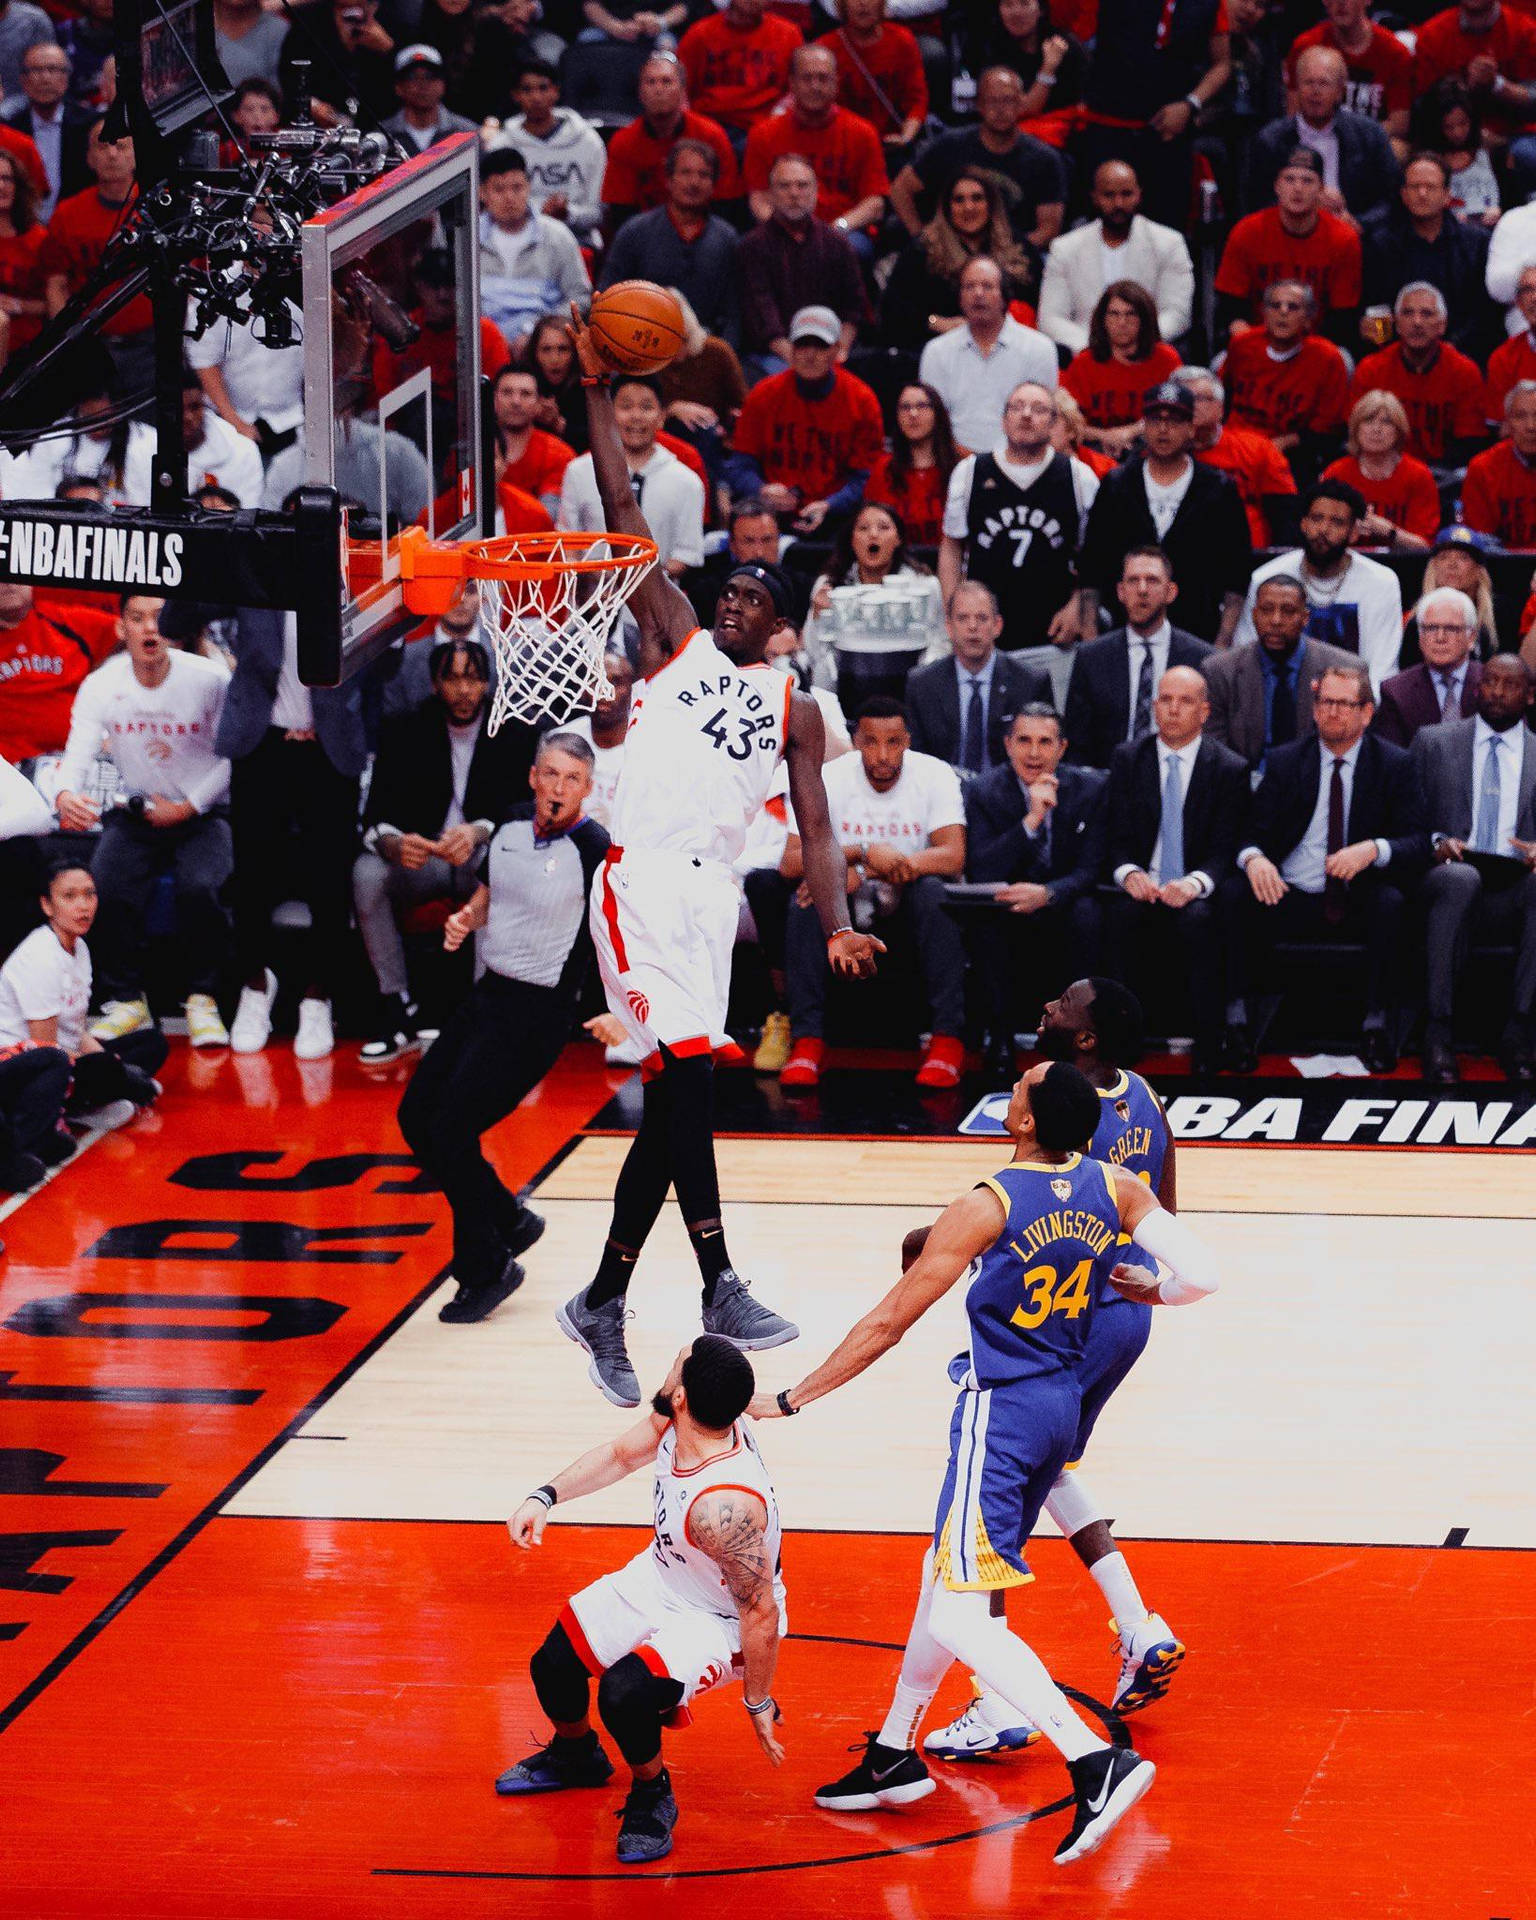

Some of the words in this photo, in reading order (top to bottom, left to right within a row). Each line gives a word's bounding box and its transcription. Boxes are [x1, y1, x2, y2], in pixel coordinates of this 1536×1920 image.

[527, 162, 584, 186] ASA
[977, 505, 1064, 549] RAPTORS
[1008, 529, 1033, 568] 7
[0, 654, 64, 681] APTORS
[677, 676, 777, 751] RAPTORS
[700, 708, 758, 761] 43
[841, 821, 923, 838] RAPTORS
[1162, 1096, 1303, 1140] BA
[1108, 1127, 1153, 1166] GREEN
[1009, 1209, 1117, 1263] LIVINGSTON
[1009, 1259, 1095, 1330] 34
